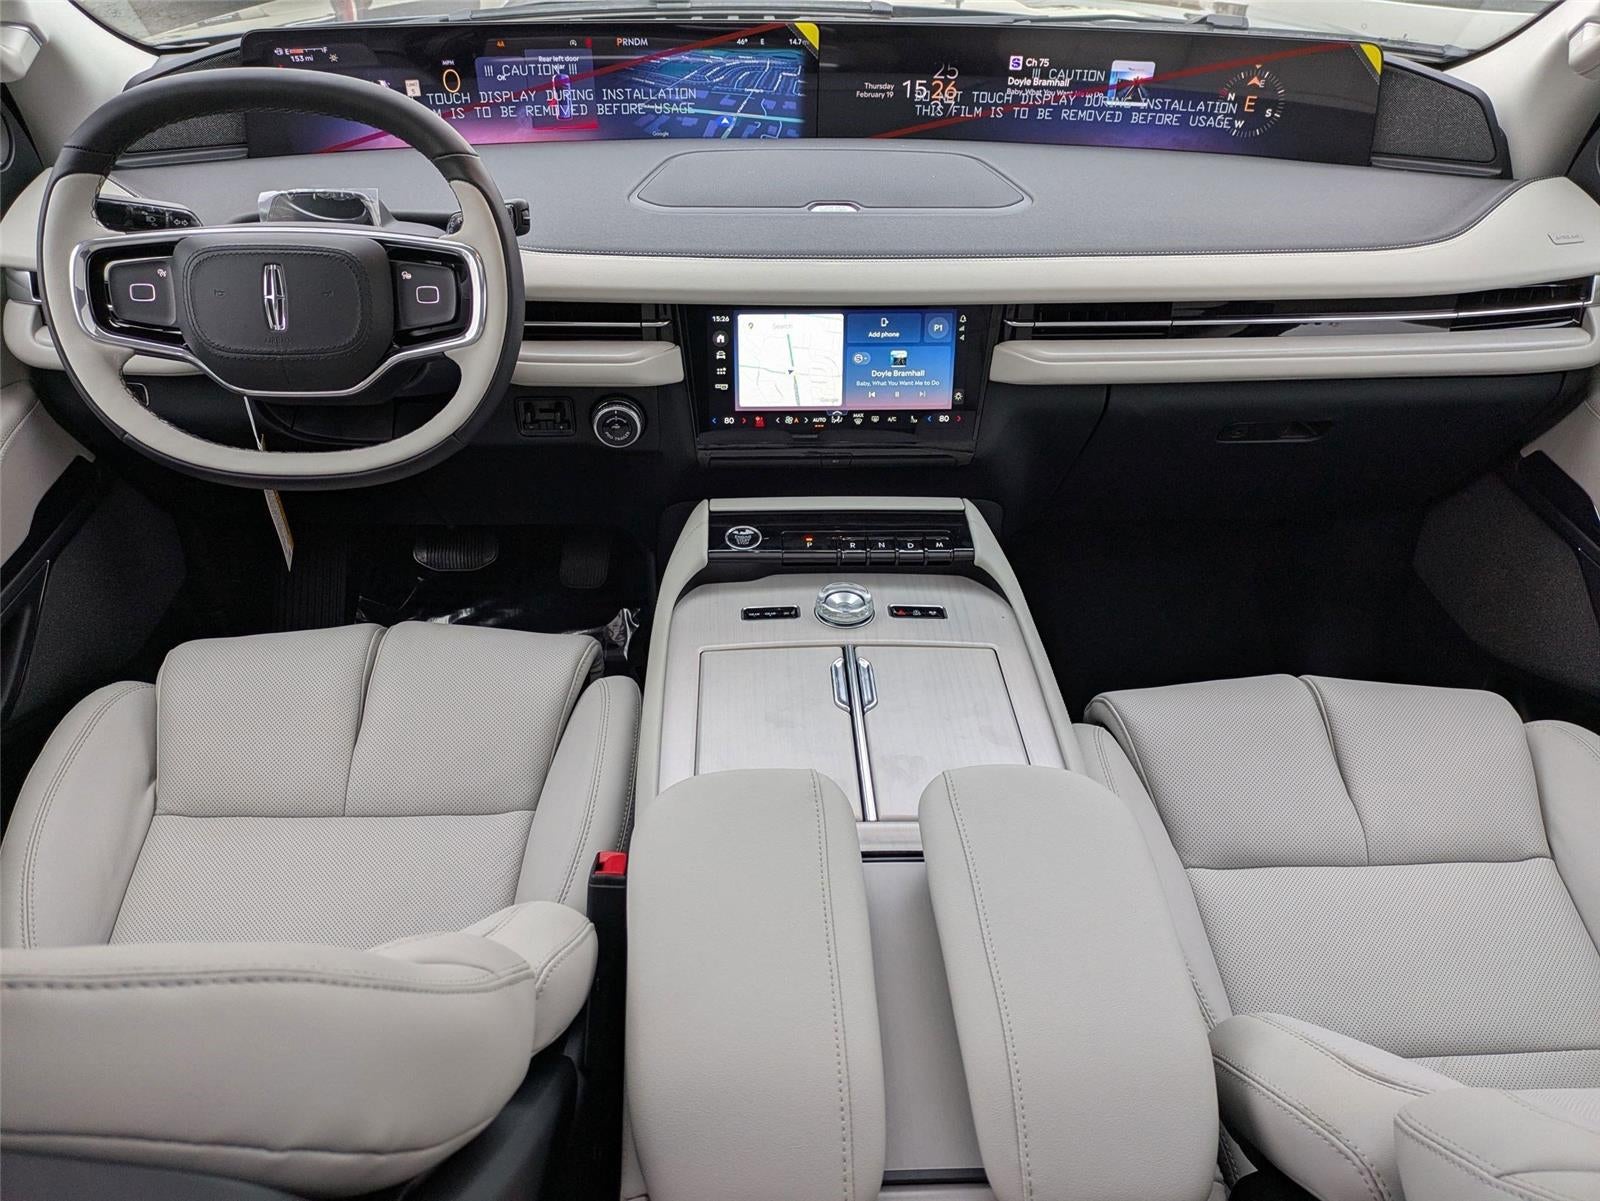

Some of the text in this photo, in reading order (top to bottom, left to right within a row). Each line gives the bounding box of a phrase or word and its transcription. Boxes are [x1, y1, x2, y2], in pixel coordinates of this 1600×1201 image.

[1025, 58, 1050, 67] Ch 75
[501, 64, 560, 76] CAUTION
[1048, 68, 1106, 82] CAUTION
[864, 82, 895, 91] Thursday
[1007, 77, 1070, 88] Doyle Bramhall
[1259, 79, 1266, 88] E
[902, 80, 957, 100] 15 26
[426, 87, 697, 105] TOUCH DISPLAY DURING INSTALLATION
[856, 91, 895, 100] February 19
[1227, 93, 1236, 101] N
[972, 91, 1013, 104] TOUCH
[1020, 93, 1076, 106] DISPLAY
[1140, 97, 1238, 114] INSTALLATION
[1243, 95, 1258, 112] E
[451, 106, 465, 119] IS
[474, 106, 492, 119] TO
[501, 105, 517, 118] BE
[526, 104, 588, 117] REMOVED
[597, 102, 646, 116] BEFORE
[655, 103, 696, 114] USAGE
[1264, 108, 1273, 118] S
[951, 105, 982, 118] FILM
[990, 106, 1004, 118] IS
[1013, 107, 1029, 119] TO
[1037, 108, 1054, 120] BE
[1061, 109, 1123, 123] REMOVED
[1130, 112, 1181, 126] BEFORE
[1189, 114, 1233, 129] USAGE
[1234, 119, 1245, 129] W
[652, 130, 669, 138] Google
[712, 315, 730, 323] 15:26
[933, 324, 944, 332] P1
[881, 331, 900, 340] phone
[871, 369, 926, 378] Doyle Bramhall
[872, 379, 887, 387] What
[888, 379, 899, 387] You
[899, 379, 914, 387] Want
[915, 379, 923, 387] Me
[924, 379, 930, 387] to
[931, 379, 940, 387] Do
[723, 416, 735, 425] 80
[938, 415, 950, 423] 80
